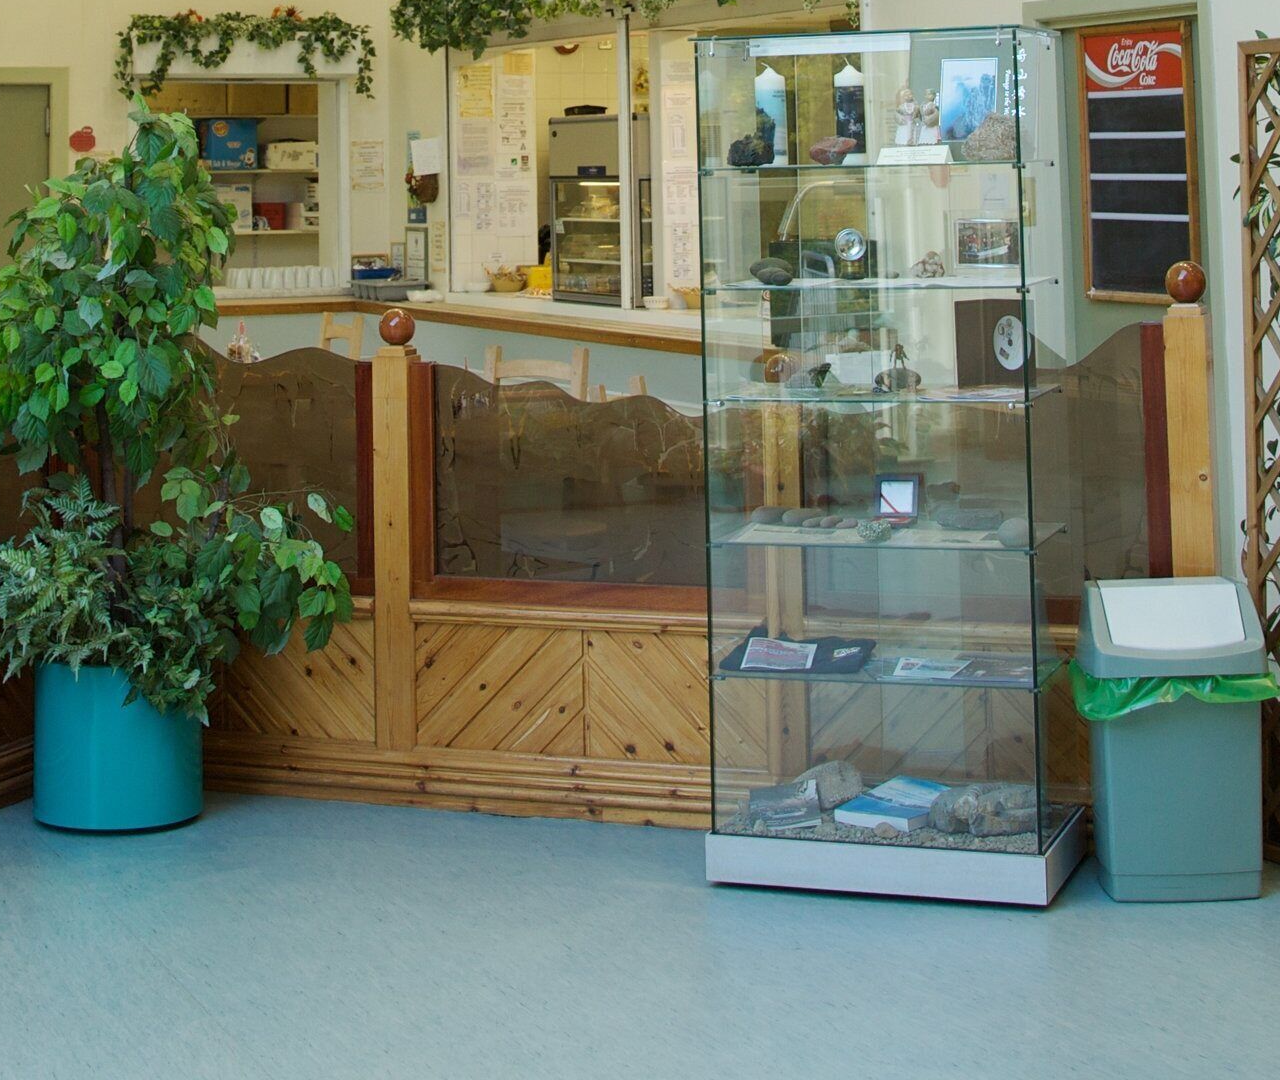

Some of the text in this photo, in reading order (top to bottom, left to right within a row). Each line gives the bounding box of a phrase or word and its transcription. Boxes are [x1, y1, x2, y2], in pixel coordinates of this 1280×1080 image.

[1121, 38, 1133, 46] Enjoy
[1107, 40, 1158, 73] Coca-Cola
[1139, 72, 1156, 85] Coke
